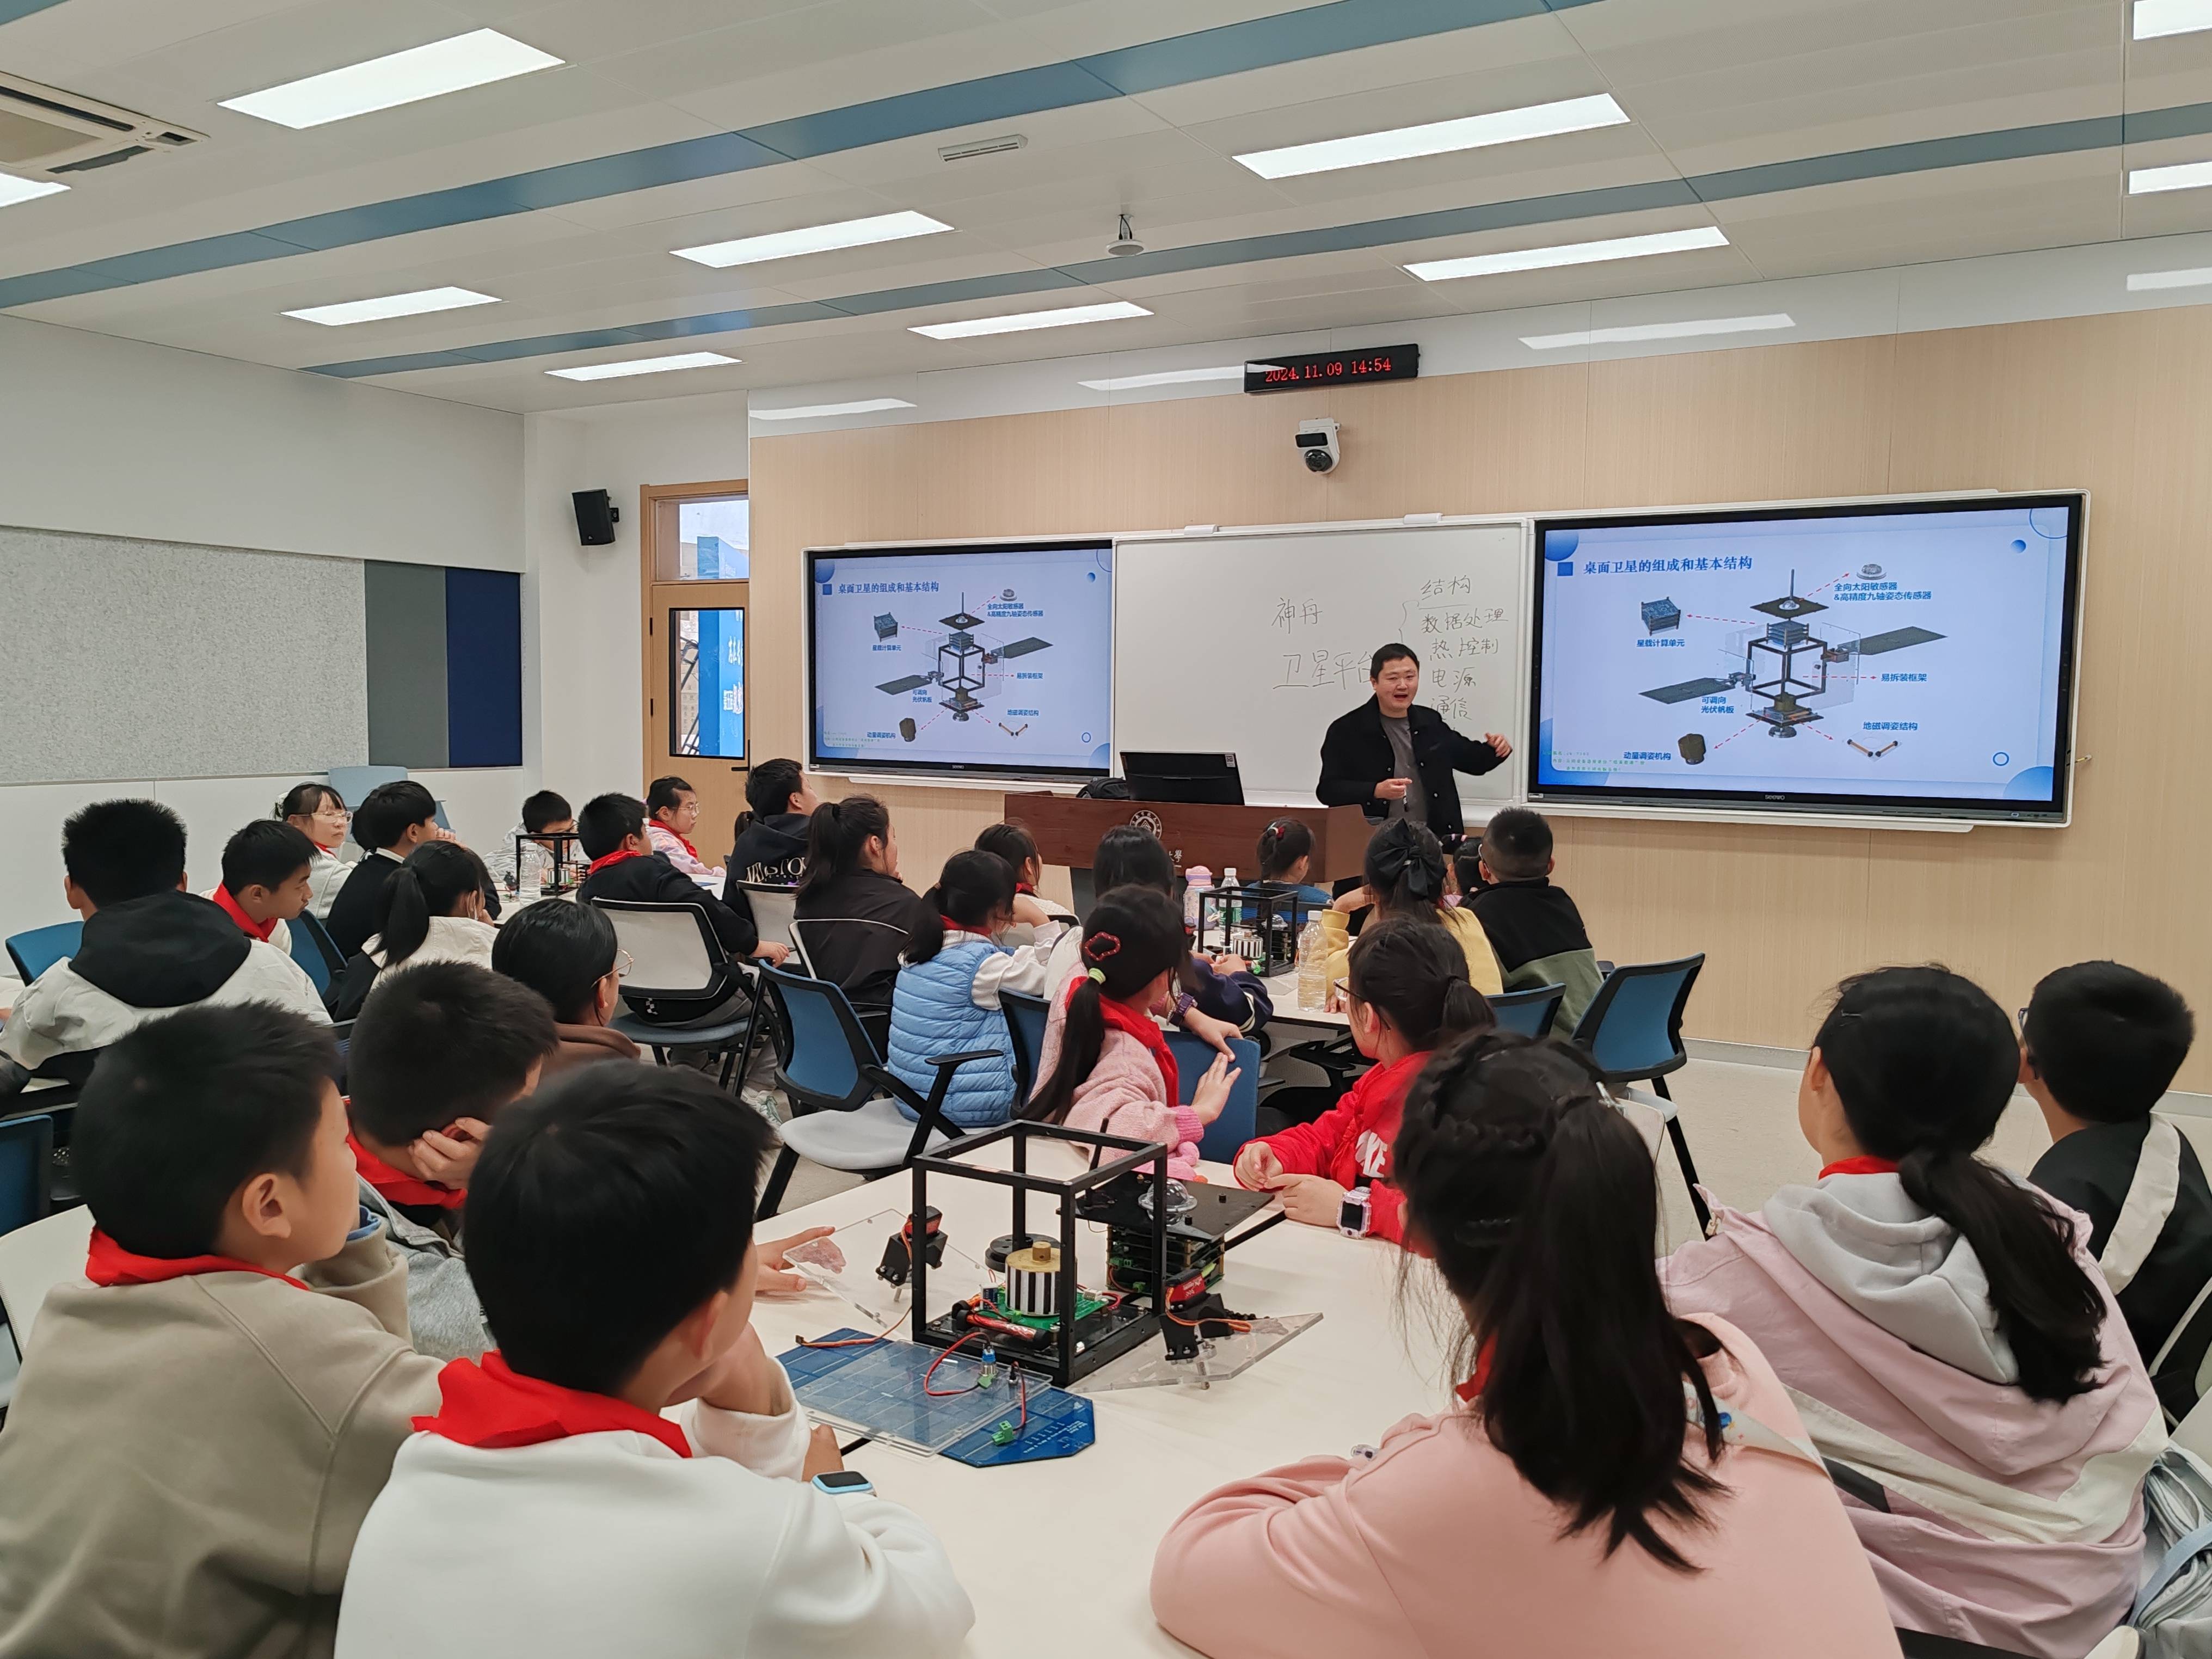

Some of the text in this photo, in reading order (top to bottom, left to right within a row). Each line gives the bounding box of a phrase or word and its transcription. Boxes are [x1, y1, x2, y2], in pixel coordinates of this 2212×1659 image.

[1351, 358, 1391, 374] 14:54
[1583, 556, 1753, 574] 桌面卫星的组成和基本结构
[838, 581, 939, 594] 桌面卫星的组成和基本结构
[1420, 575, 1471, 600] 结构
[1834, 582, 1898, 592] 全向太阳敏感器
[1834, 591, 1932, 601] &高精度九轴姿态传感器
[1271, 598, 1323, 634] 神舟
[1418, 608, 1508, 634] 数据处理
[1637, 638, 1685, 647] 星载计算单元
[1432, 667, 1477, 693] 电源
[1881, 673, 1927, 682] 易拆装框架
[1701, 696, 1726, 704] 可调向
[1700, 705, 1735, 714] 光伏帆板
[1863, 721, 1918, 731] 地磁调姿结构
[1624, 752, 1671, 760] 动量调姿机构
